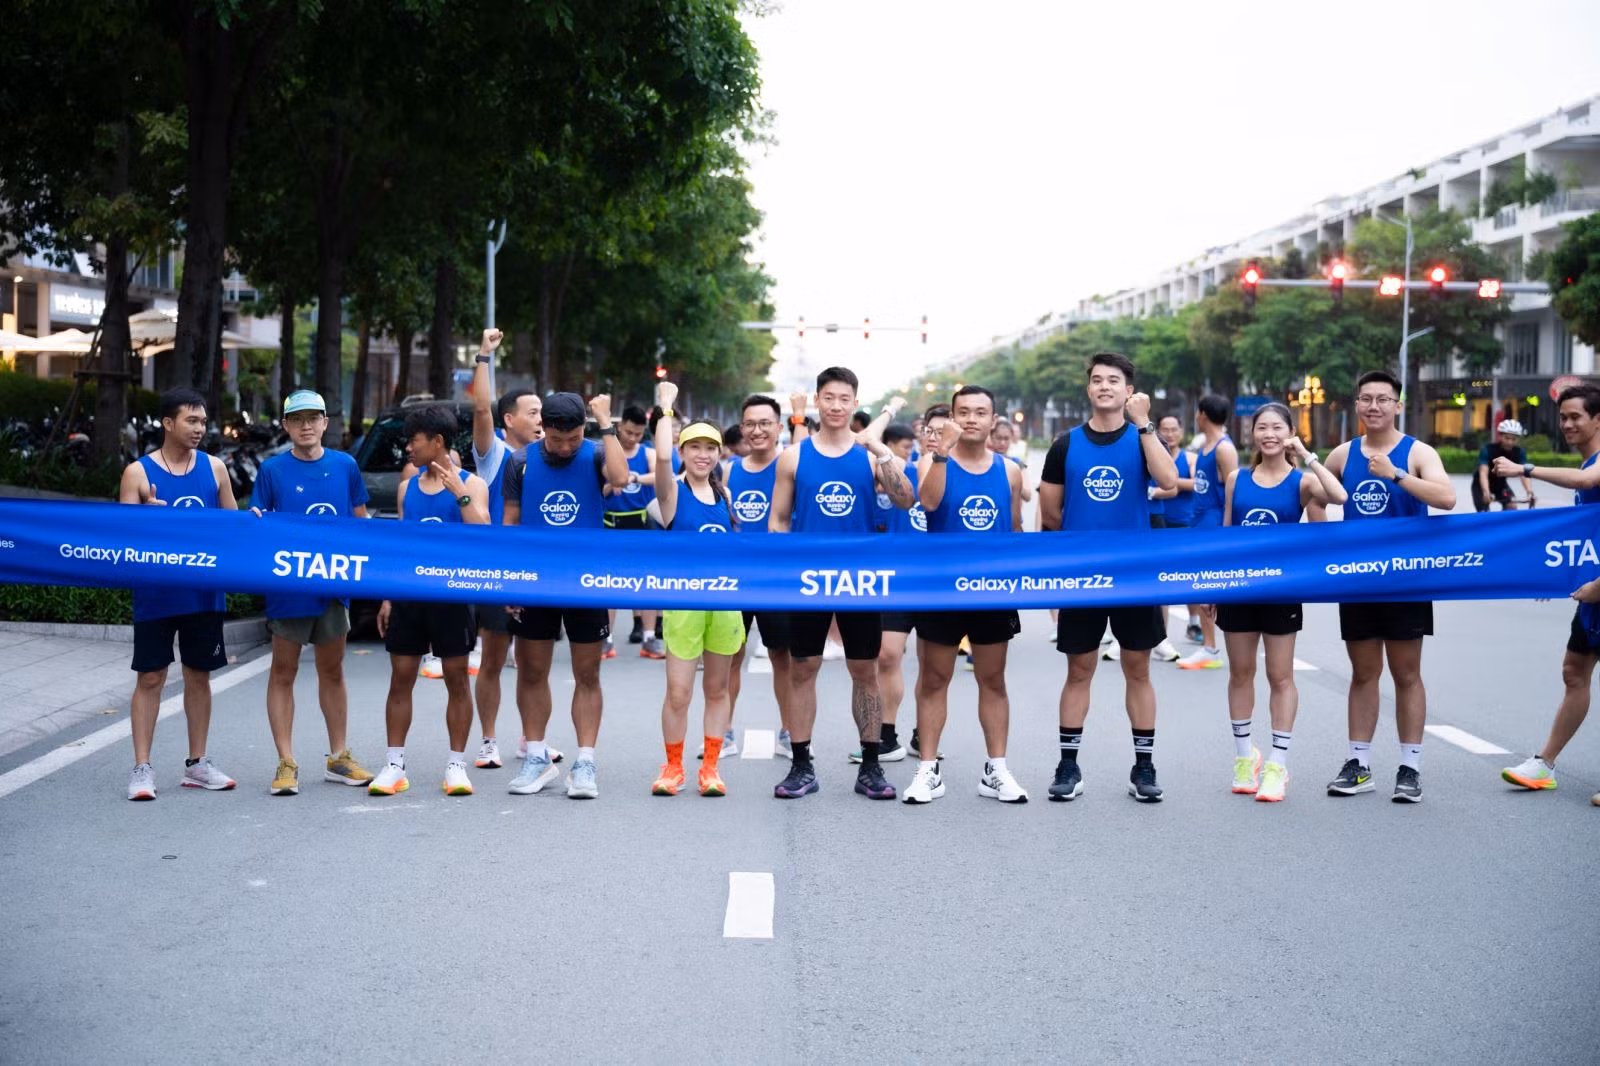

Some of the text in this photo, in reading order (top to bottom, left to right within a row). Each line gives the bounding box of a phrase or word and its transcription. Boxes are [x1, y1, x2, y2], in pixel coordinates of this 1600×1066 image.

[1083, 478, 1124, 490] Galaxy
[816, 493, 857, 505] Galaxy
[1352, 492, 1390, 503] Galaxy
[540, 503, 580, 514] Galaxy
[734, 501, 770, 513] Galaxy
[959, 507, 998, 519] Galaxy
[59, 544, 217, 568] Galaxy RunnerzZz
[272, 550, 369, 581] START
[1325, 551, 1484, 576] Galaxy RunnerzZz
[415, 566, 538, 581] Galaxy Watch8 Series
[1158, 567, 1282, 583] Galaxy Watch8 Series
[447, 580, 493, 591] Galaxy AI
[580, 573, 738, 592] Galaxy RunnerzZz
[799, 569, 896, 597] START
[955, 574, 1113, 594] Galaxy RunnerzZz
[1191, 581, 1227, 590] Galaxy
